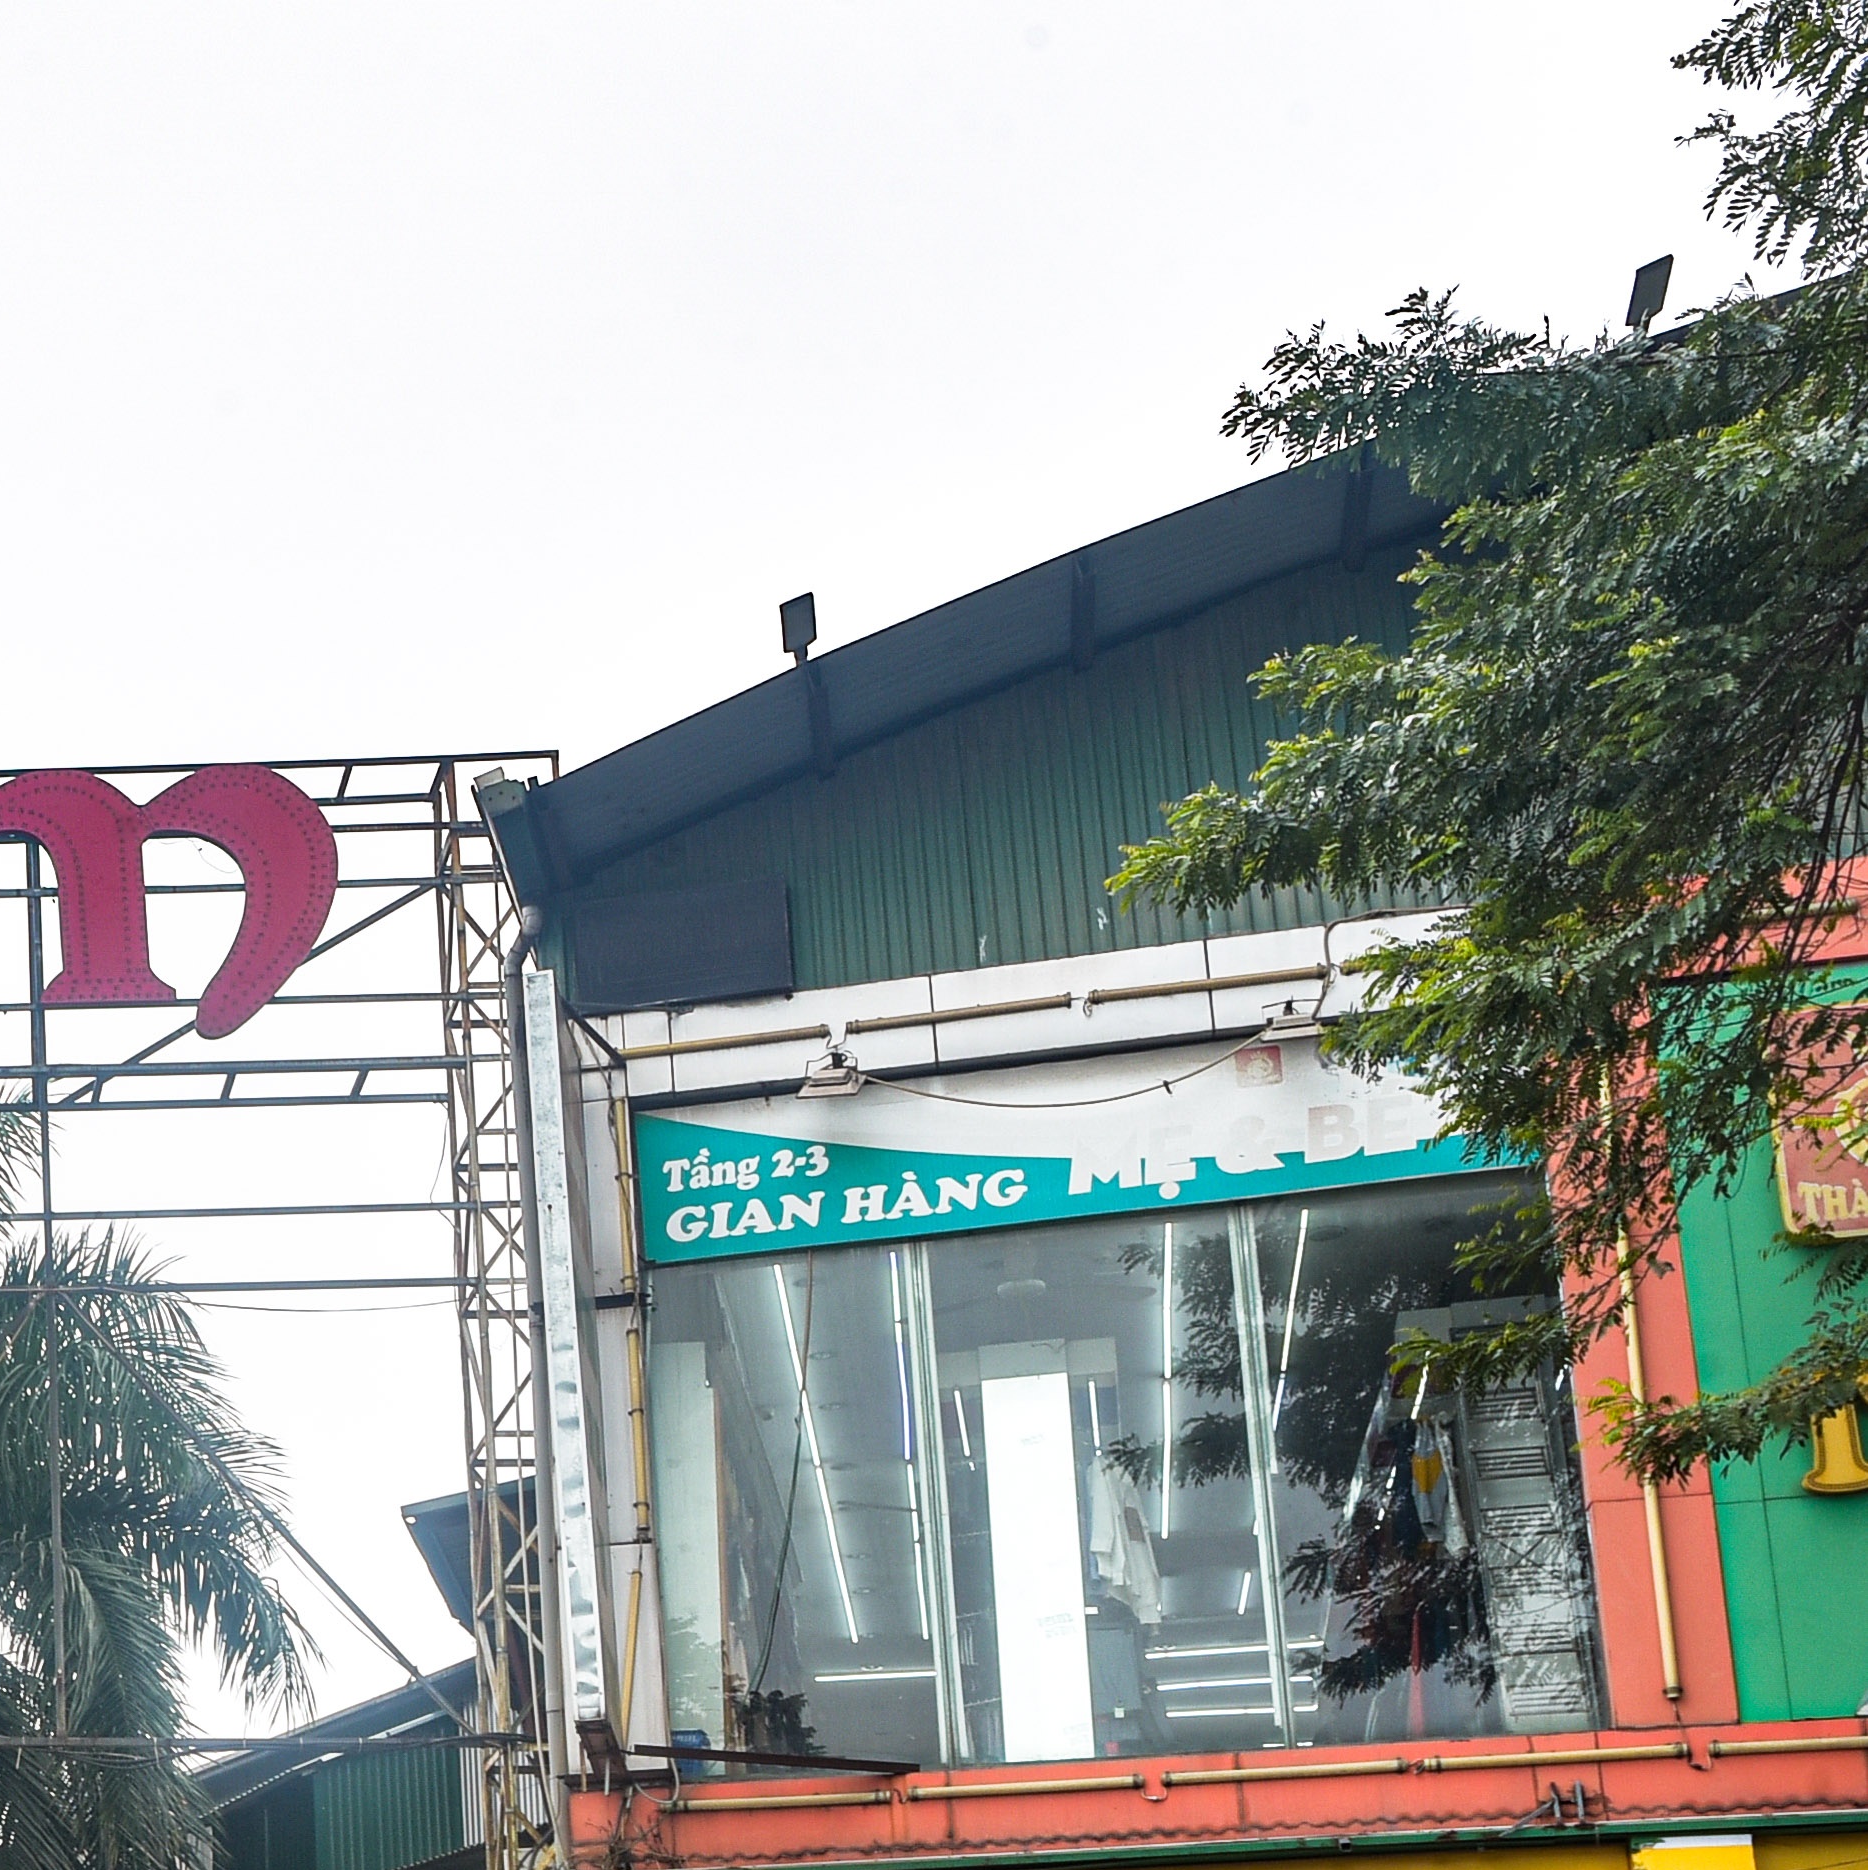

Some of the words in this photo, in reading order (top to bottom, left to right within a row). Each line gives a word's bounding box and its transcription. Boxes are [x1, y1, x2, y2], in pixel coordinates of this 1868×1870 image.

[661, 1146, 761, 1194] Tầng
[770, 1144, 831, 1179] 2-3
[665, 1190, 826, 1243] GIAN
[840, 1169, 1029, 1224] HÀNG
[1067, 1124, 1197, 1200] MẸ
[1215, 1115, 1285, 1175] &
